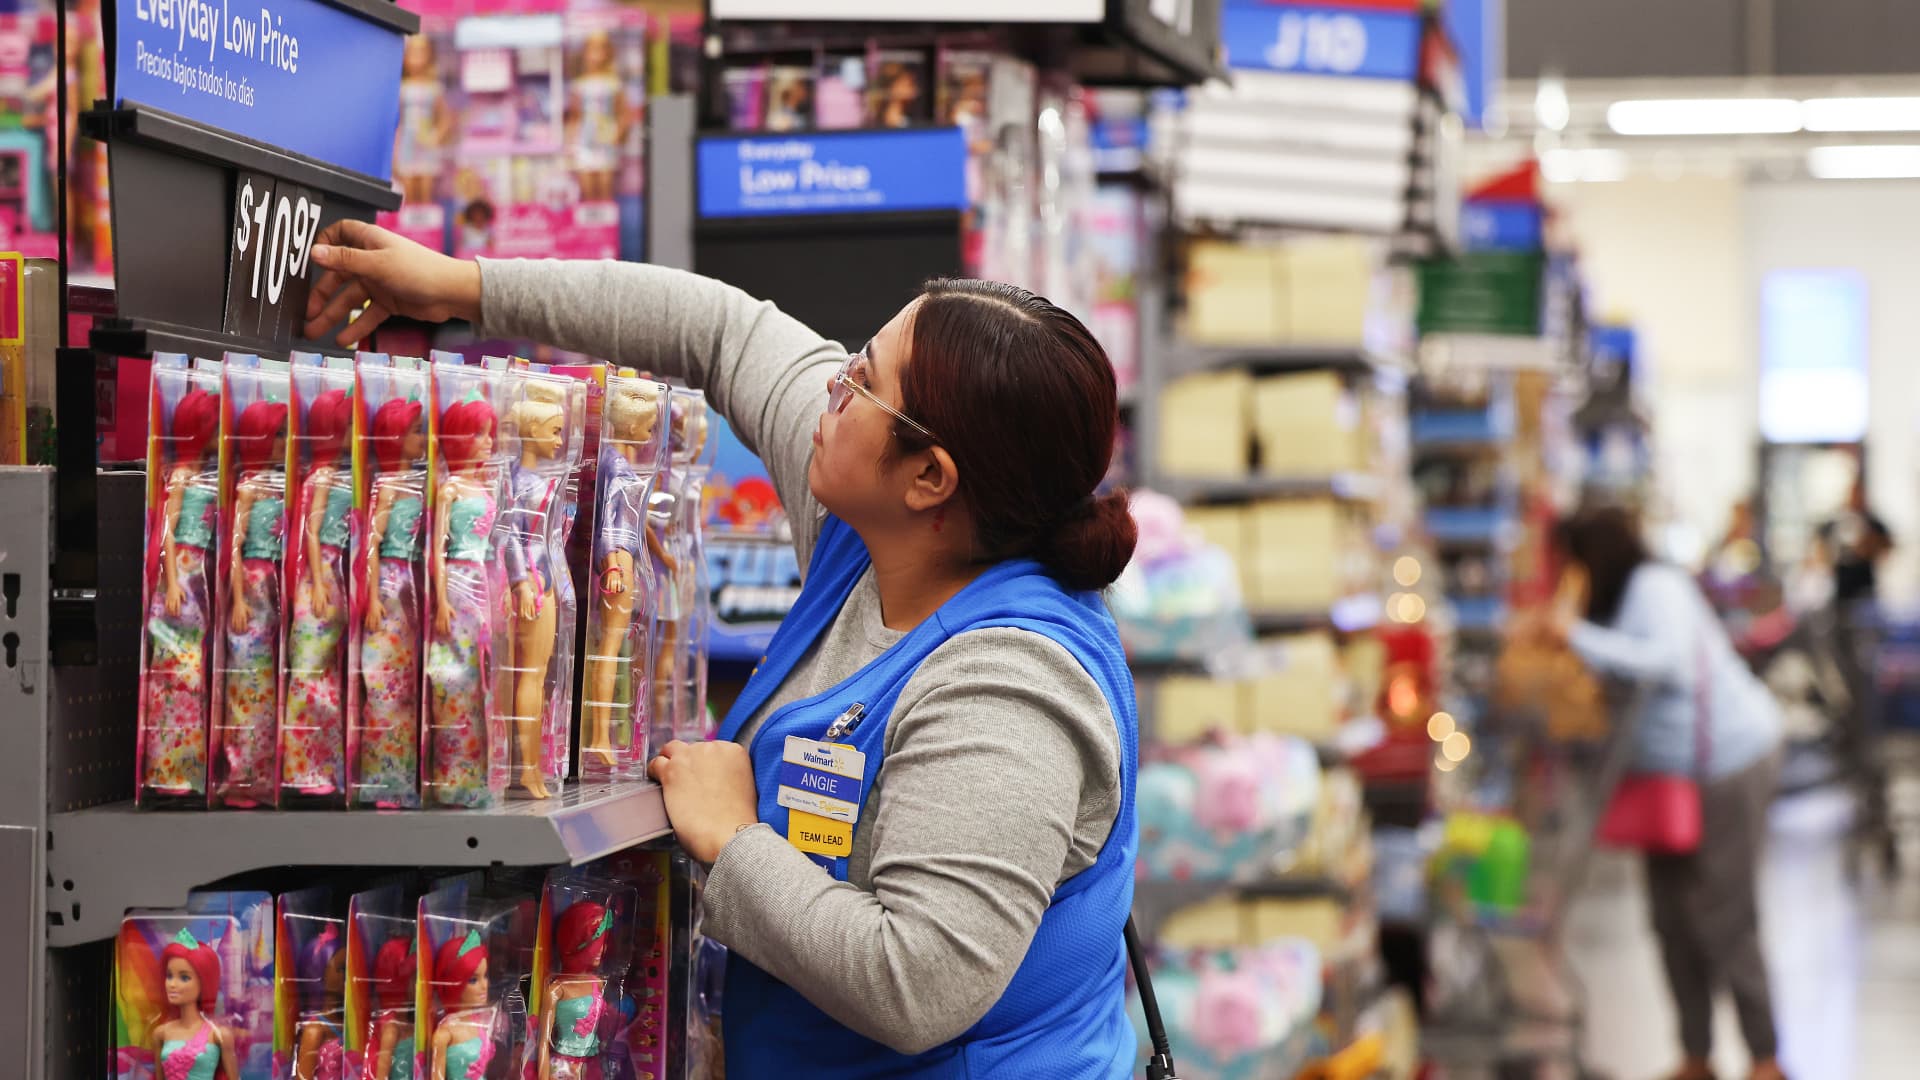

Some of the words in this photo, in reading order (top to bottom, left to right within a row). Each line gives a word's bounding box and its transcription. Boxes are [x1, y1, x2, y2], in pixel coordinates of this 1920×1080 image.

[223, 0, 257, 59] Low
[260, 8, 299, 74] Price
[136, 39, 172, 81] Precios
[173, 53, 197, 95] bajos
[198, 65, 223, 97] todos
[224, 71, 237, 102] los
[238, 76, 255, 108] días
[740, 164, 797, 194] Low
[799, 160, 871, 191] Price
[803, 752, 834, 767] Walmart
[801, 773, 838, 793] ANGIE
[800, 831, 821, 844] TEAM
[823, 834, 844, 846] LEAD
